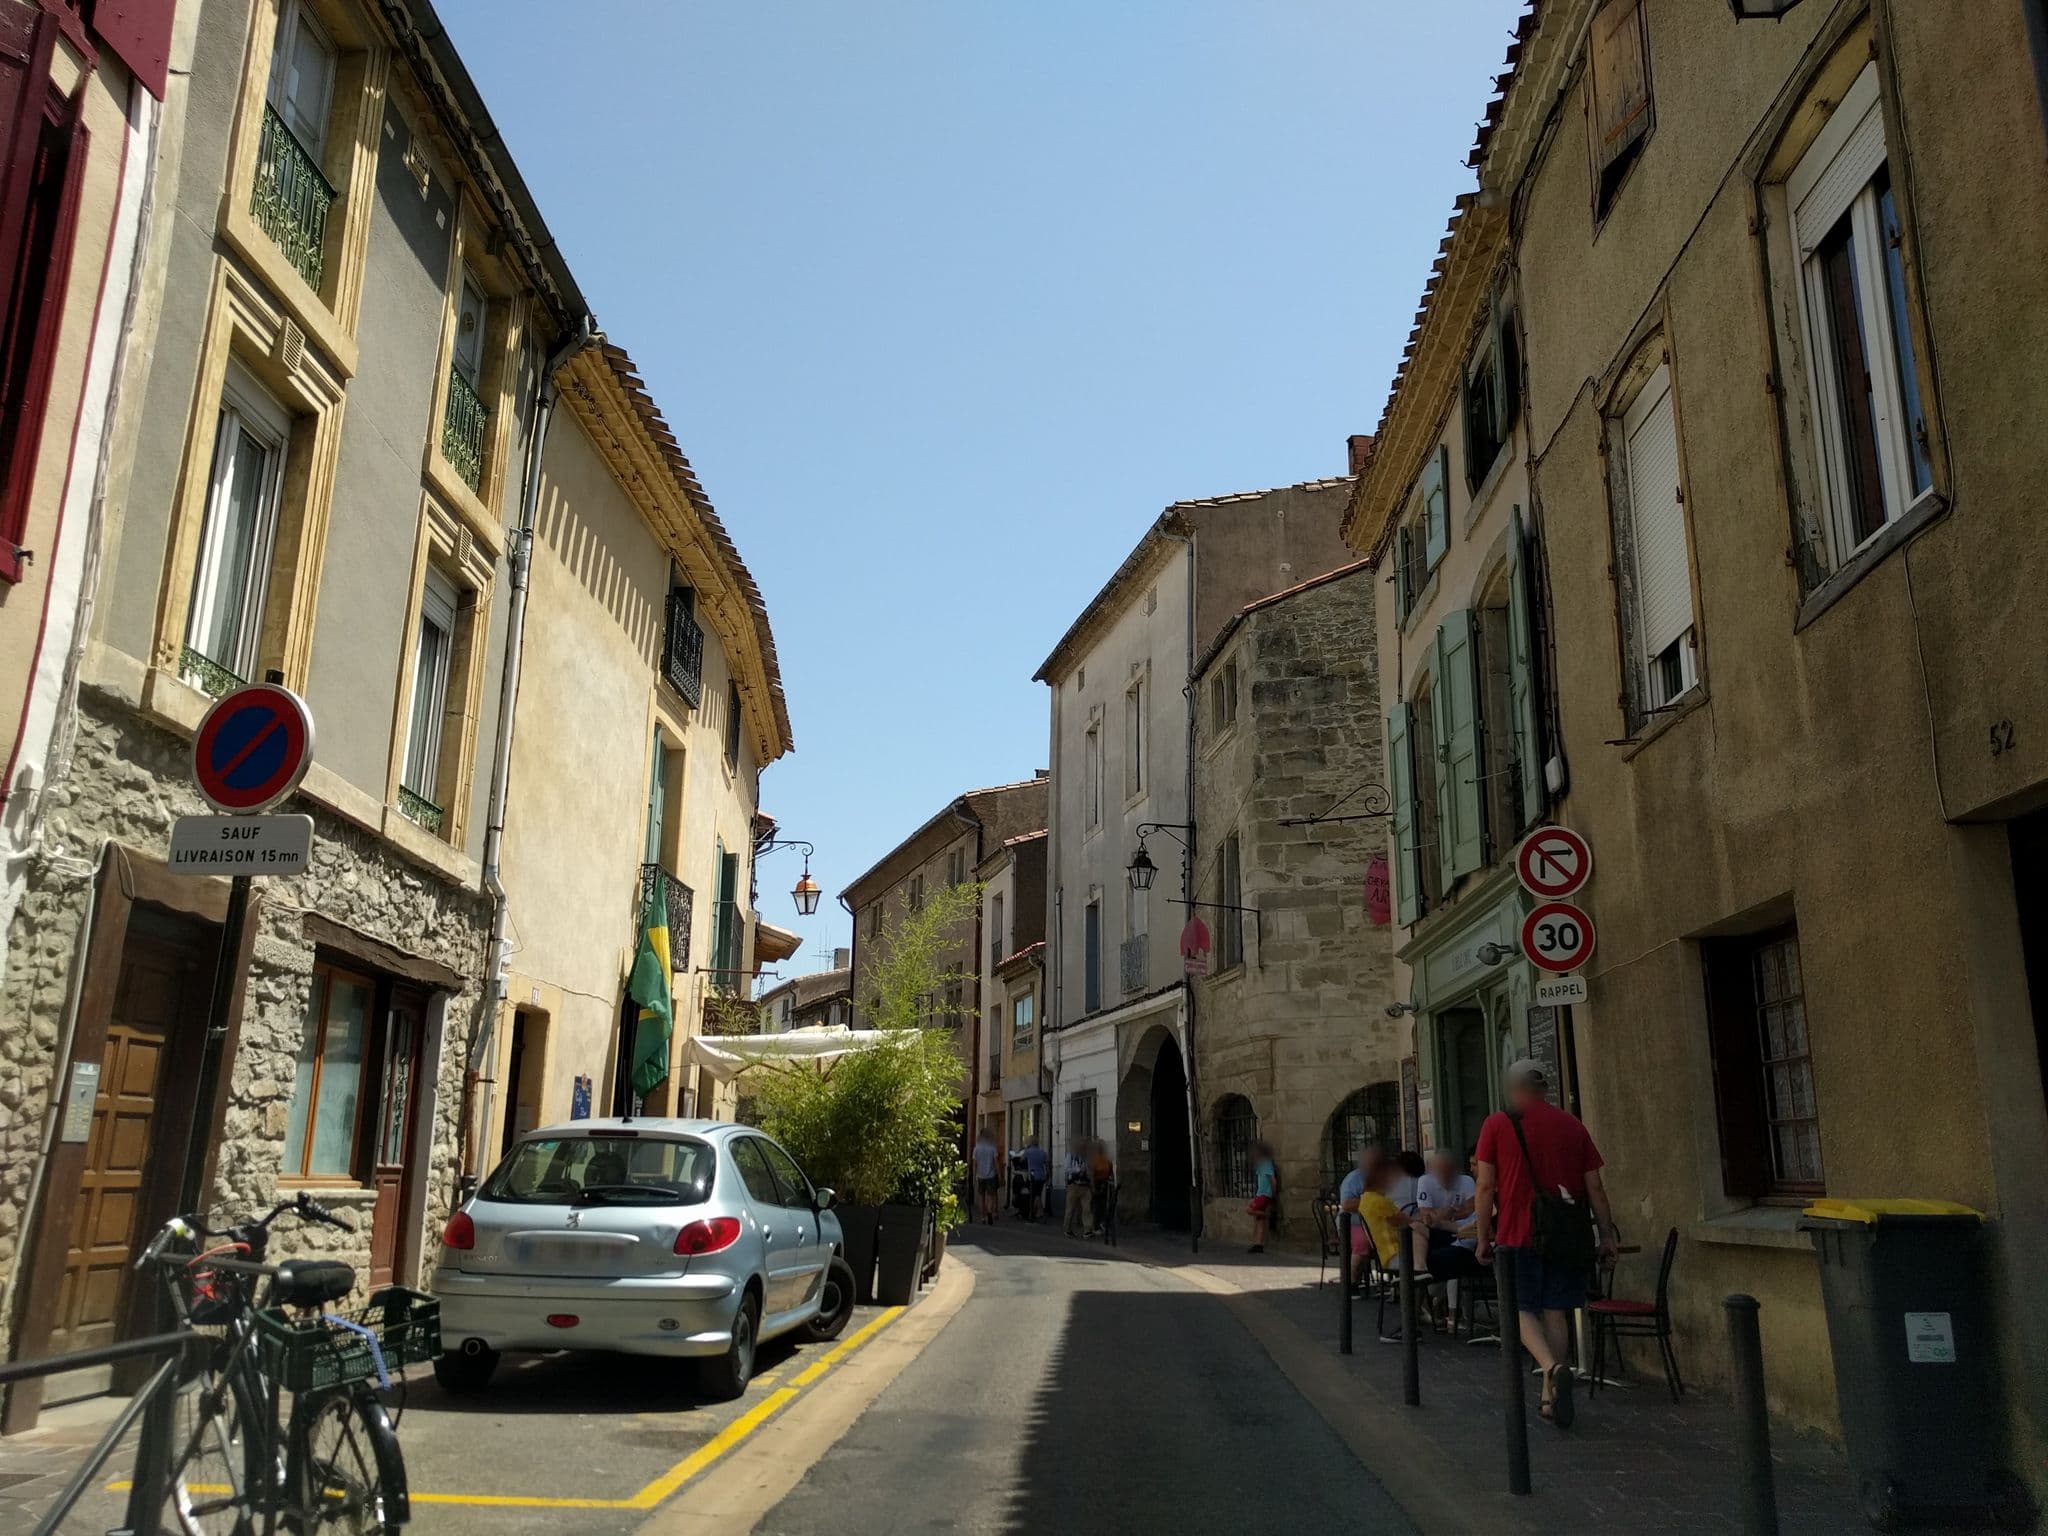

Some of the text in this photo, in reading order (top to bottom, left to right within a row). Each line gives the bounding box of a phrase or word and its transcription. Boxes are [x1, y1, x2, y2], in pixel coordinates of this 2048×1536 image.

[1990, 719, 2016, 758] 52
[221, 826, 261, 840] SAUF
[175, 849, 254, 863] LIVRAISON
[1538, 923, 1579, 951] 30
[1540, 983, 1583, 998] RAPPEL
